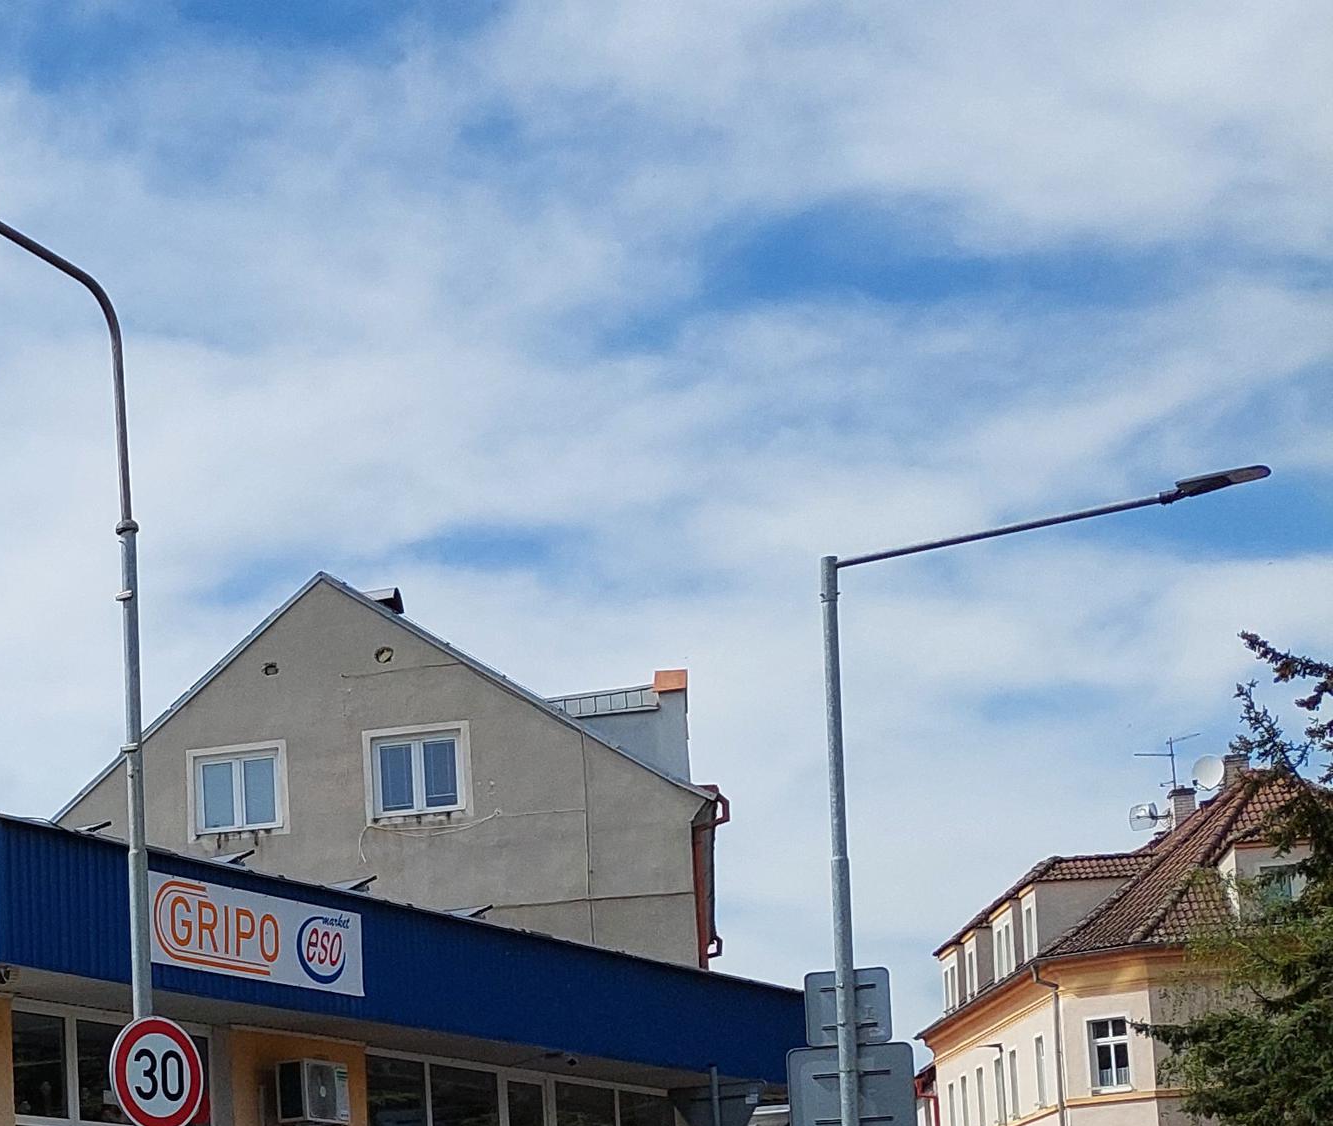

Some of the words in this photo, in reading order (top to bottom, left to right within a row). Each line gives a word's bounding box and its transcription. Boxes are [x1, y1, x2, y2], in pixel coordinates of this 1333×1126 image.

[170, 896, 280, 962] GRIPO
[321, 913, 351, 929] market
[306, 927, 342, 967] eso
[134, 1048, 184, 1101] 30
